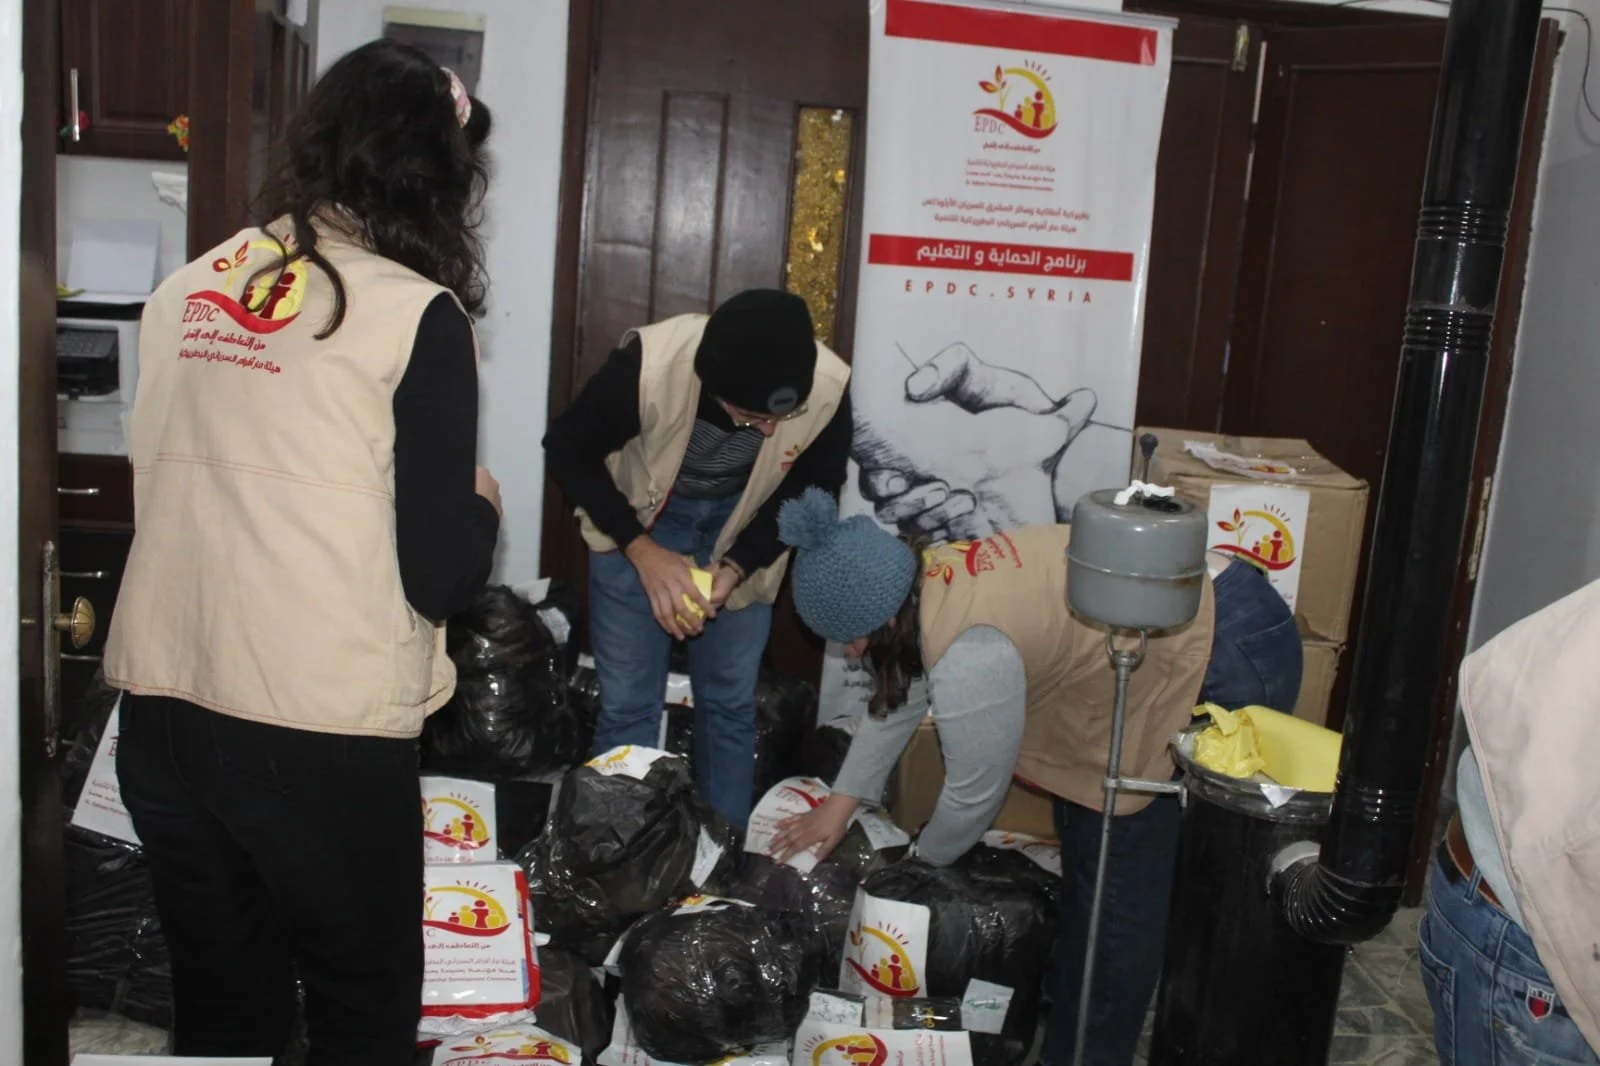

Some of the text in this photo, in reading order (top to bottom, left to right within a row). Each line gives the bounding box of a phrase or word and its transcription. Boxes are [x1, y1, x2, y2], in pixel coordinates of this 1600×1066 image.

[974, 115, 1005, 134] EPDC
[916, 242, 1087, 274] برنامج الحماية و التعليم
[182, 301, 220, 323] EPDC
[218, 333, 256, 350] التعاطف
[253, 340, 266, 351] من
[263, 361, 281, 374] هيئة
